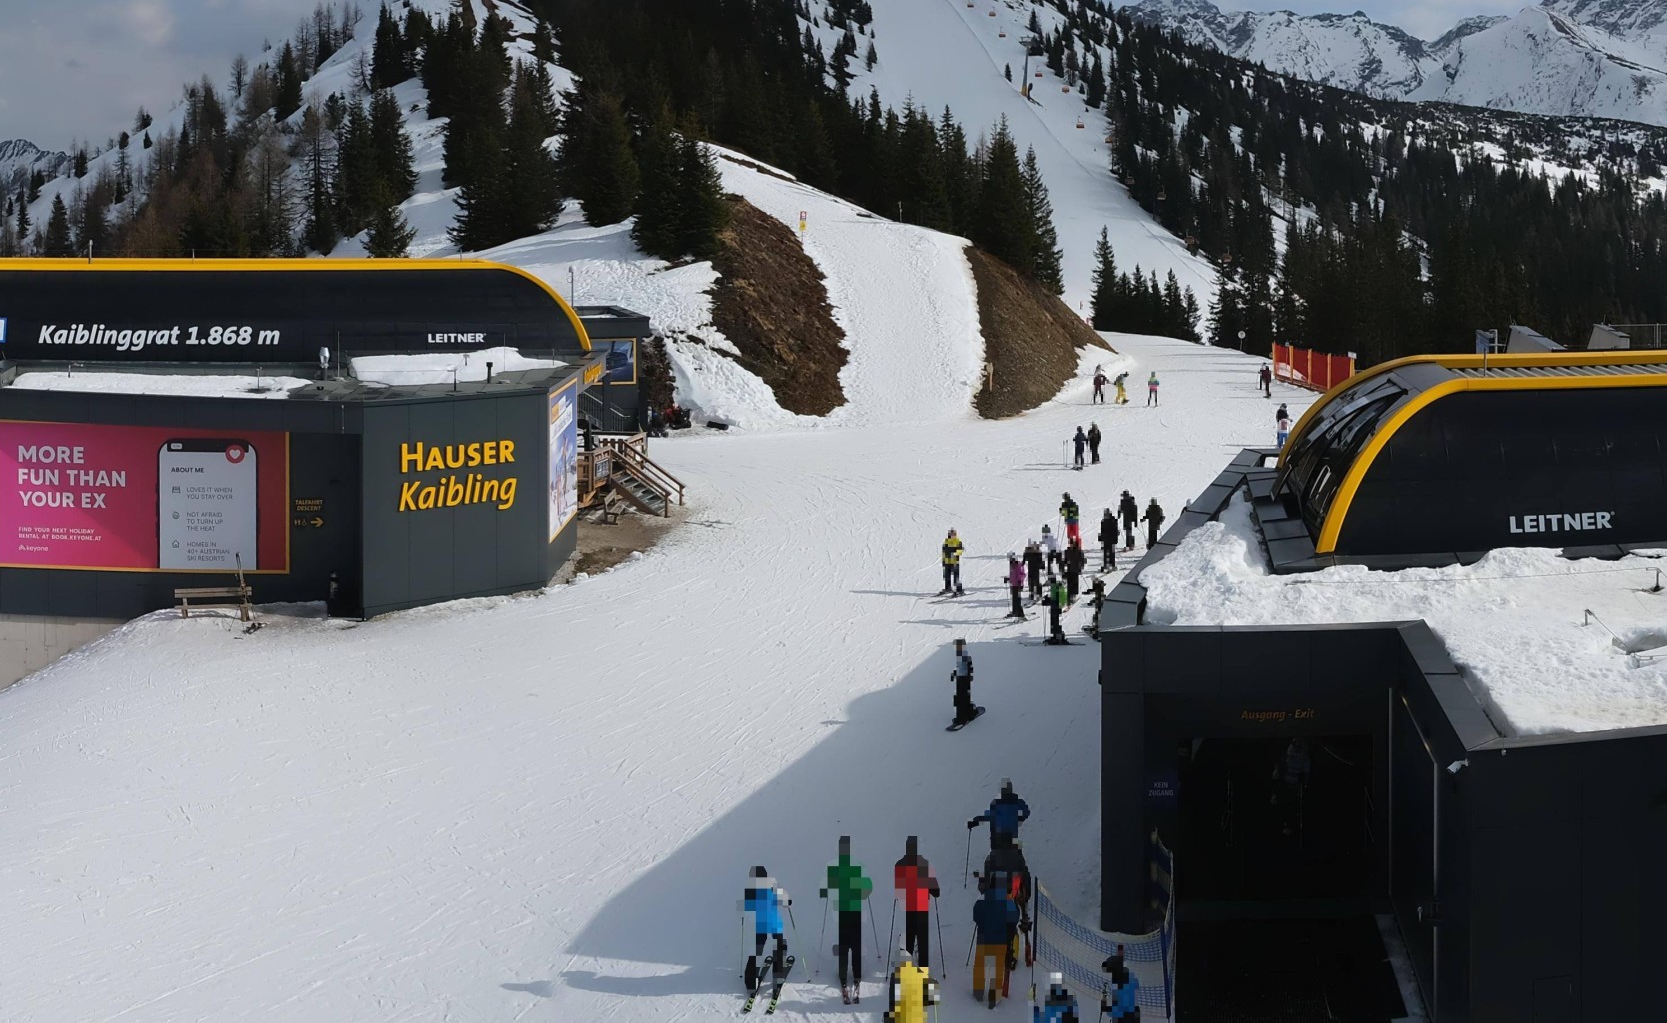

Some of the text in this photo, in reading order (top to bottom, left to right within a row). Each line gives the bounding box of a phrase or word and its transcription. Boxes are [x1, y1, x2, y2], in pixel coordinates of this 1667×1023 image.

[38, 324, 281, 351] Kaiblinggrat 1.868 m
[428, 333, 485, 343] LEITNER
[18, 445, 85, 464] MORE
[401, 440, 515, 473] HAUSER
[18, 468, 126, 487] FUN THAN
[19, 491, 106, 509] YOUR EX
[399, 473, 518, 512] Kaibling
[1509, 511, 1613, 534] LEITNER
[1240, 709, 1286, 722] Ausgang
[1294, 708, 1315, 719] Exit
[1148, 789, 1174, 797] ZUGANG
